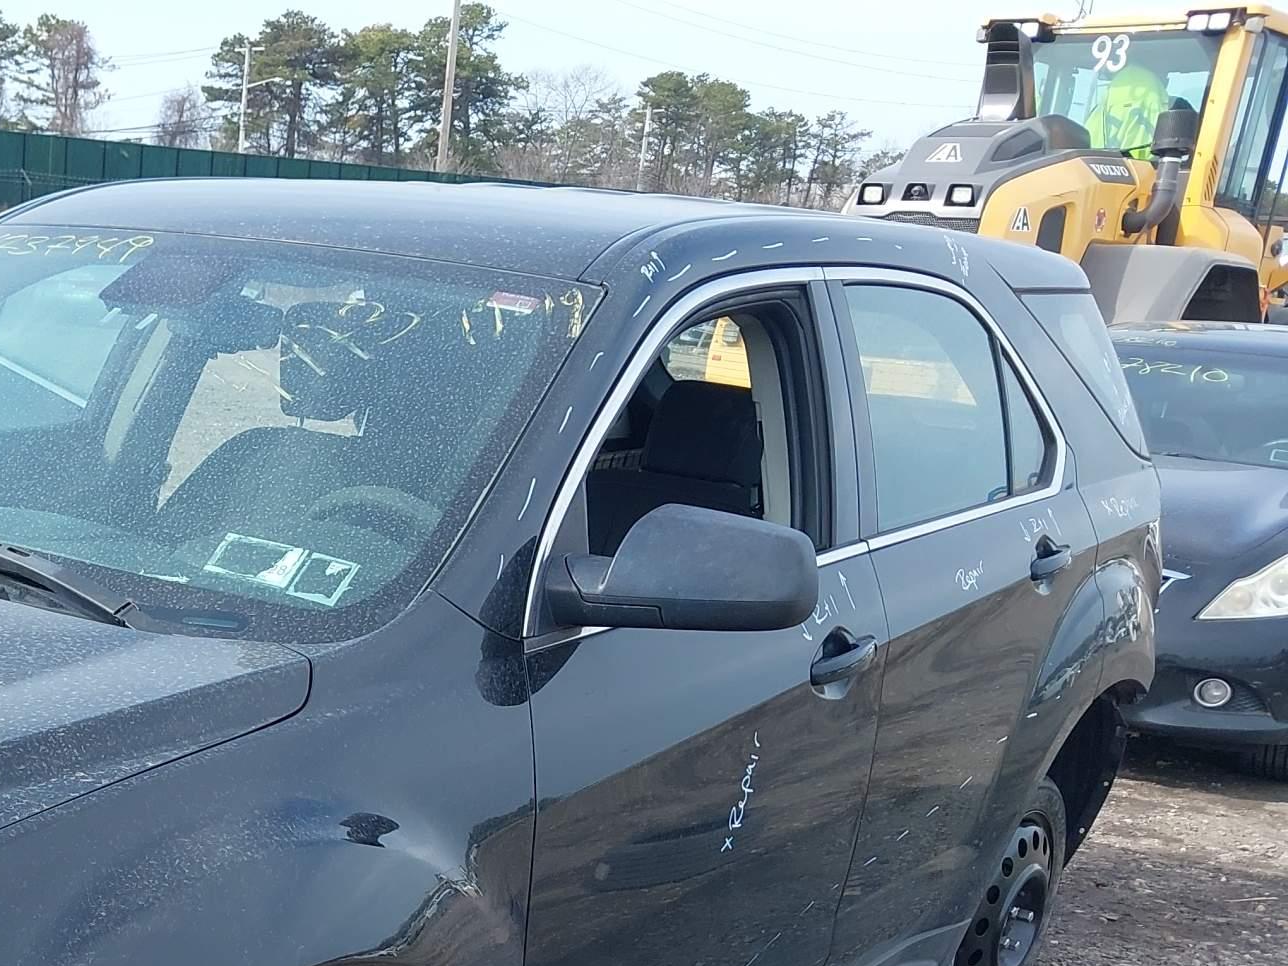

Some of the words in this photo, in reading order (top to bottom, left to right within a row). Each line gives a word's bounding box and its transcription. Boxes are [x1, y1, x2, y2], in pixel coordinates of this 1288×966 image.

[1091, 34, 1130, 73] 93
[1089, 164, 1130, 177] VOLVO
[955, 559, 984, 590] Repair
[728, 730, 761, 831] Repair
